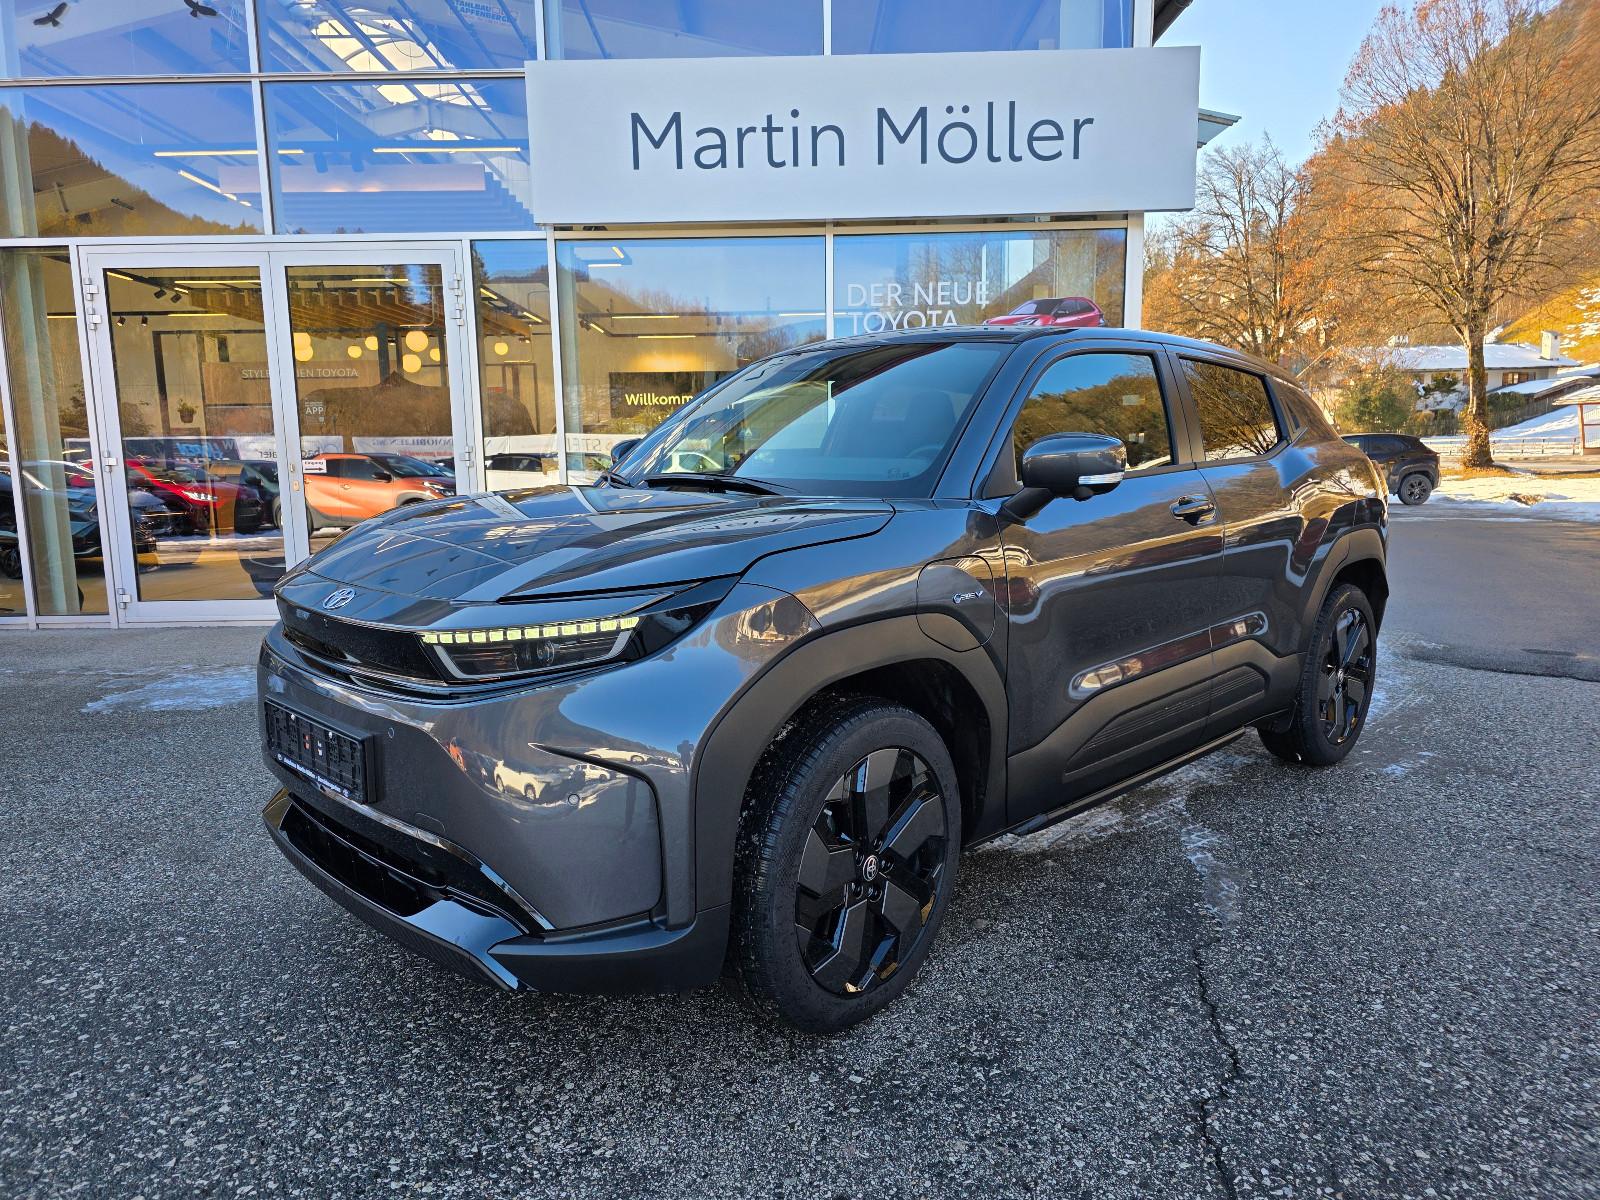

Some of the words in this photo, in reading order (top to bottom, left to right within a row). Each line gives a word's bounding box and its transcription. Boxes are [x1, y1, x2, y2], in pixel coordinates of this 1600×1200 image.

[630, 108, 845, 170] Martin
[877, 100, 1095, 165] Möller
[847, 283, 903, 307] DER
[914, 281, 990, 306] NEUE
[847, 309, 958, 336] TOYOTA
[317, 368, 359, 378] TOYOTA
[625, 393, 693, 406] Willkomm
[305, 406, 324, 415] APP
